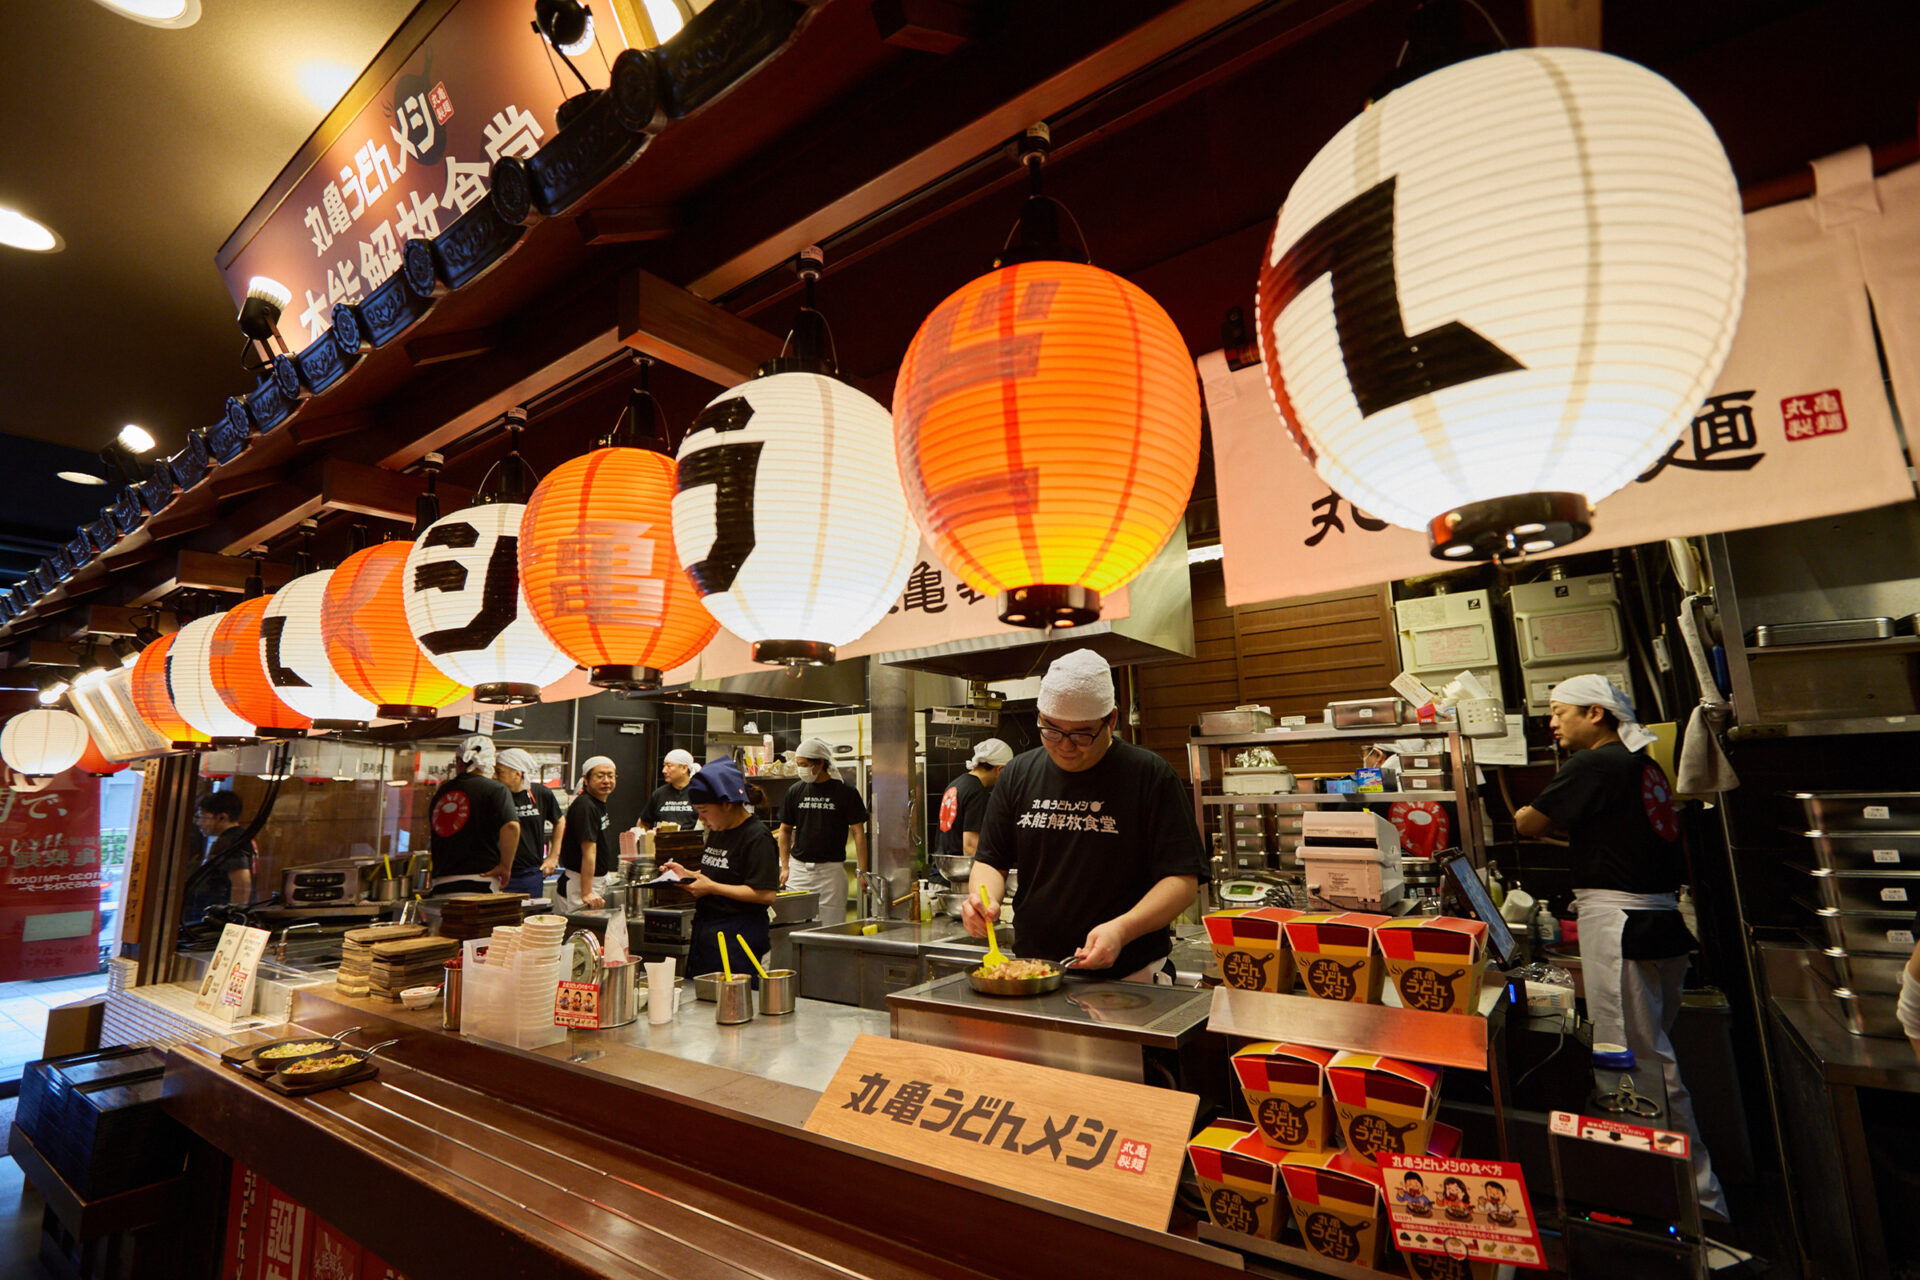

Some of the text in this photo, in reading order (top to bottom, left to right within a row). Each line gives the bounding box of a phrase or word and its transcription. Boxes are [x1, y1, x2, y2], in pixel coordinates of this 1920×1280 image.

[303, 92, 436, 258] 丸亀うどんメシ
[414, 521, 519, 657] シ
[1016, 811, 1119, 835] 本能解放食堂
[1313, 968, 1351, 988] うどん
[1411, 968, 1436, 982] 丸亀
[1404, 978, 1449, 998] うどん
[1416, 995, 1444, 1011] メシ
[1268, 1101, 1291, 1113] 丸亀
[840, 1072, 1119, 1171] 丸亀うどんメシ
[1263, 1110, 1303, 1129] うどん
[1273, 1125, 1300, 1143] メシ
[1354, 1125, 1399, 1150] うどん
[1391, 1155, 1503, 1177] 丸亀うどんメシの食べ方
